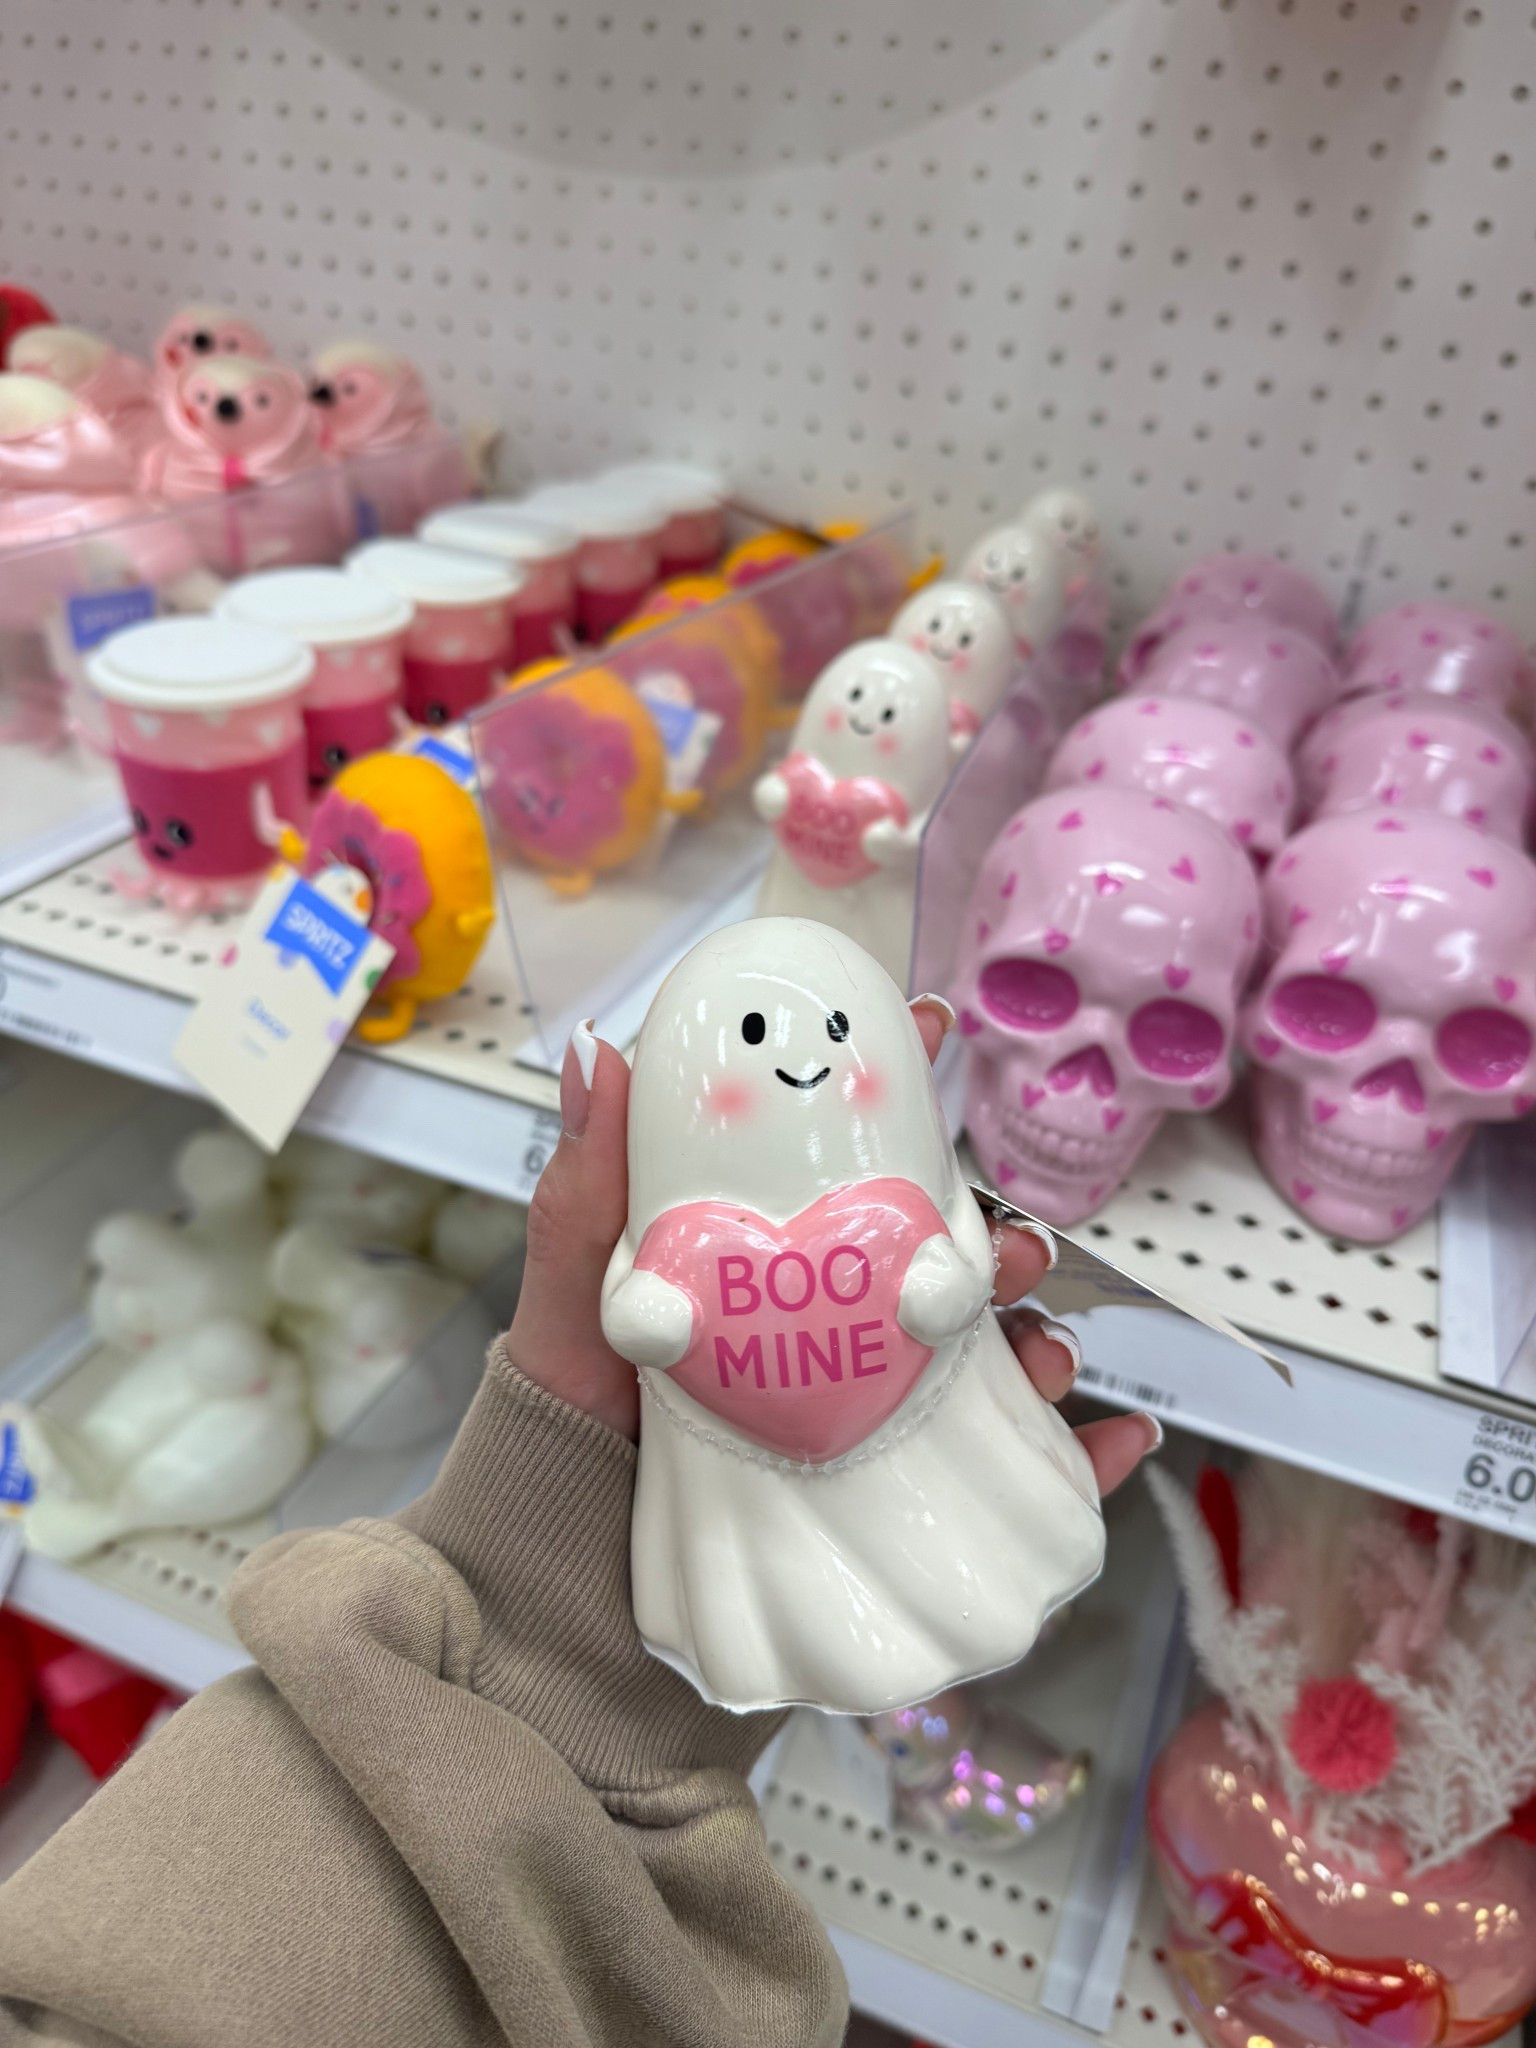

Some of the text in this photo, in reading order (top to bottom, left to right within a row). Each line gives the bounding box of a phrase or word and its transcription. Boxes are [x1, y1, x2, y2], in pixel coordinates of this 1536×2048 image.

[282, 901, 354, 970] SPRITZ
[718, 1245, 871, 1316] BOO
[714, 1319, 888, 1389] MINE
[1477, 1415, 1536, 1446] SPRI
